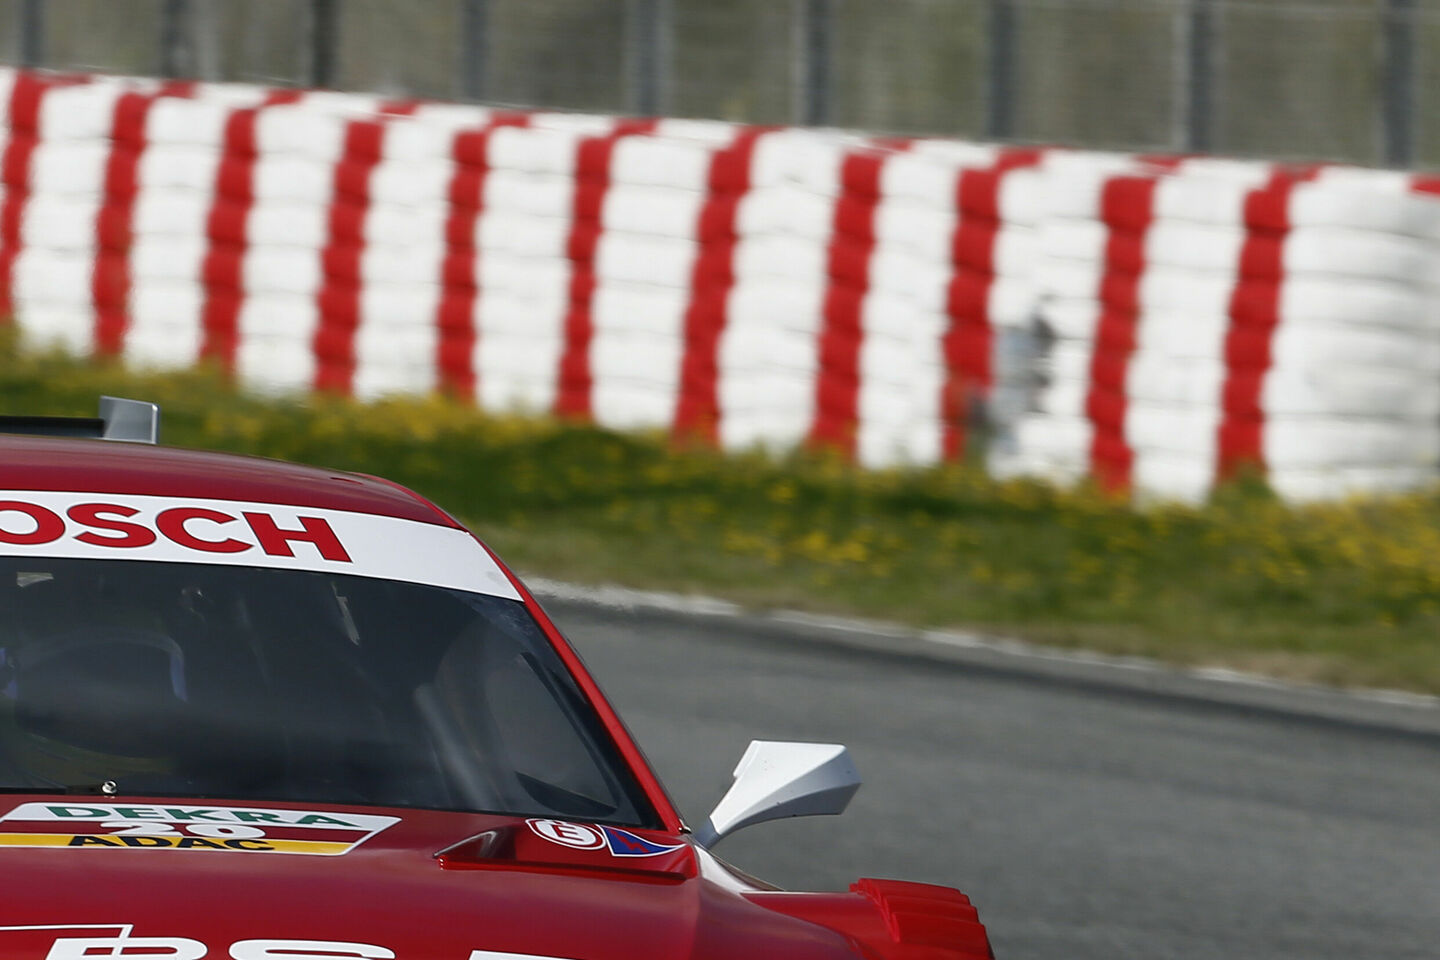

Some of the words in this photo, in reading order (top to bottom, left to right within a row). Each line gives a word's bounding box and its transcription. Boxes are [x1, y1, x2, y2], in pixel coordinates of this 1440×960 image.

[46, 805, 363, 828] DEKRA
[100, 820, 268, 839] 20
[67, 834, 276, 853] ADAC
